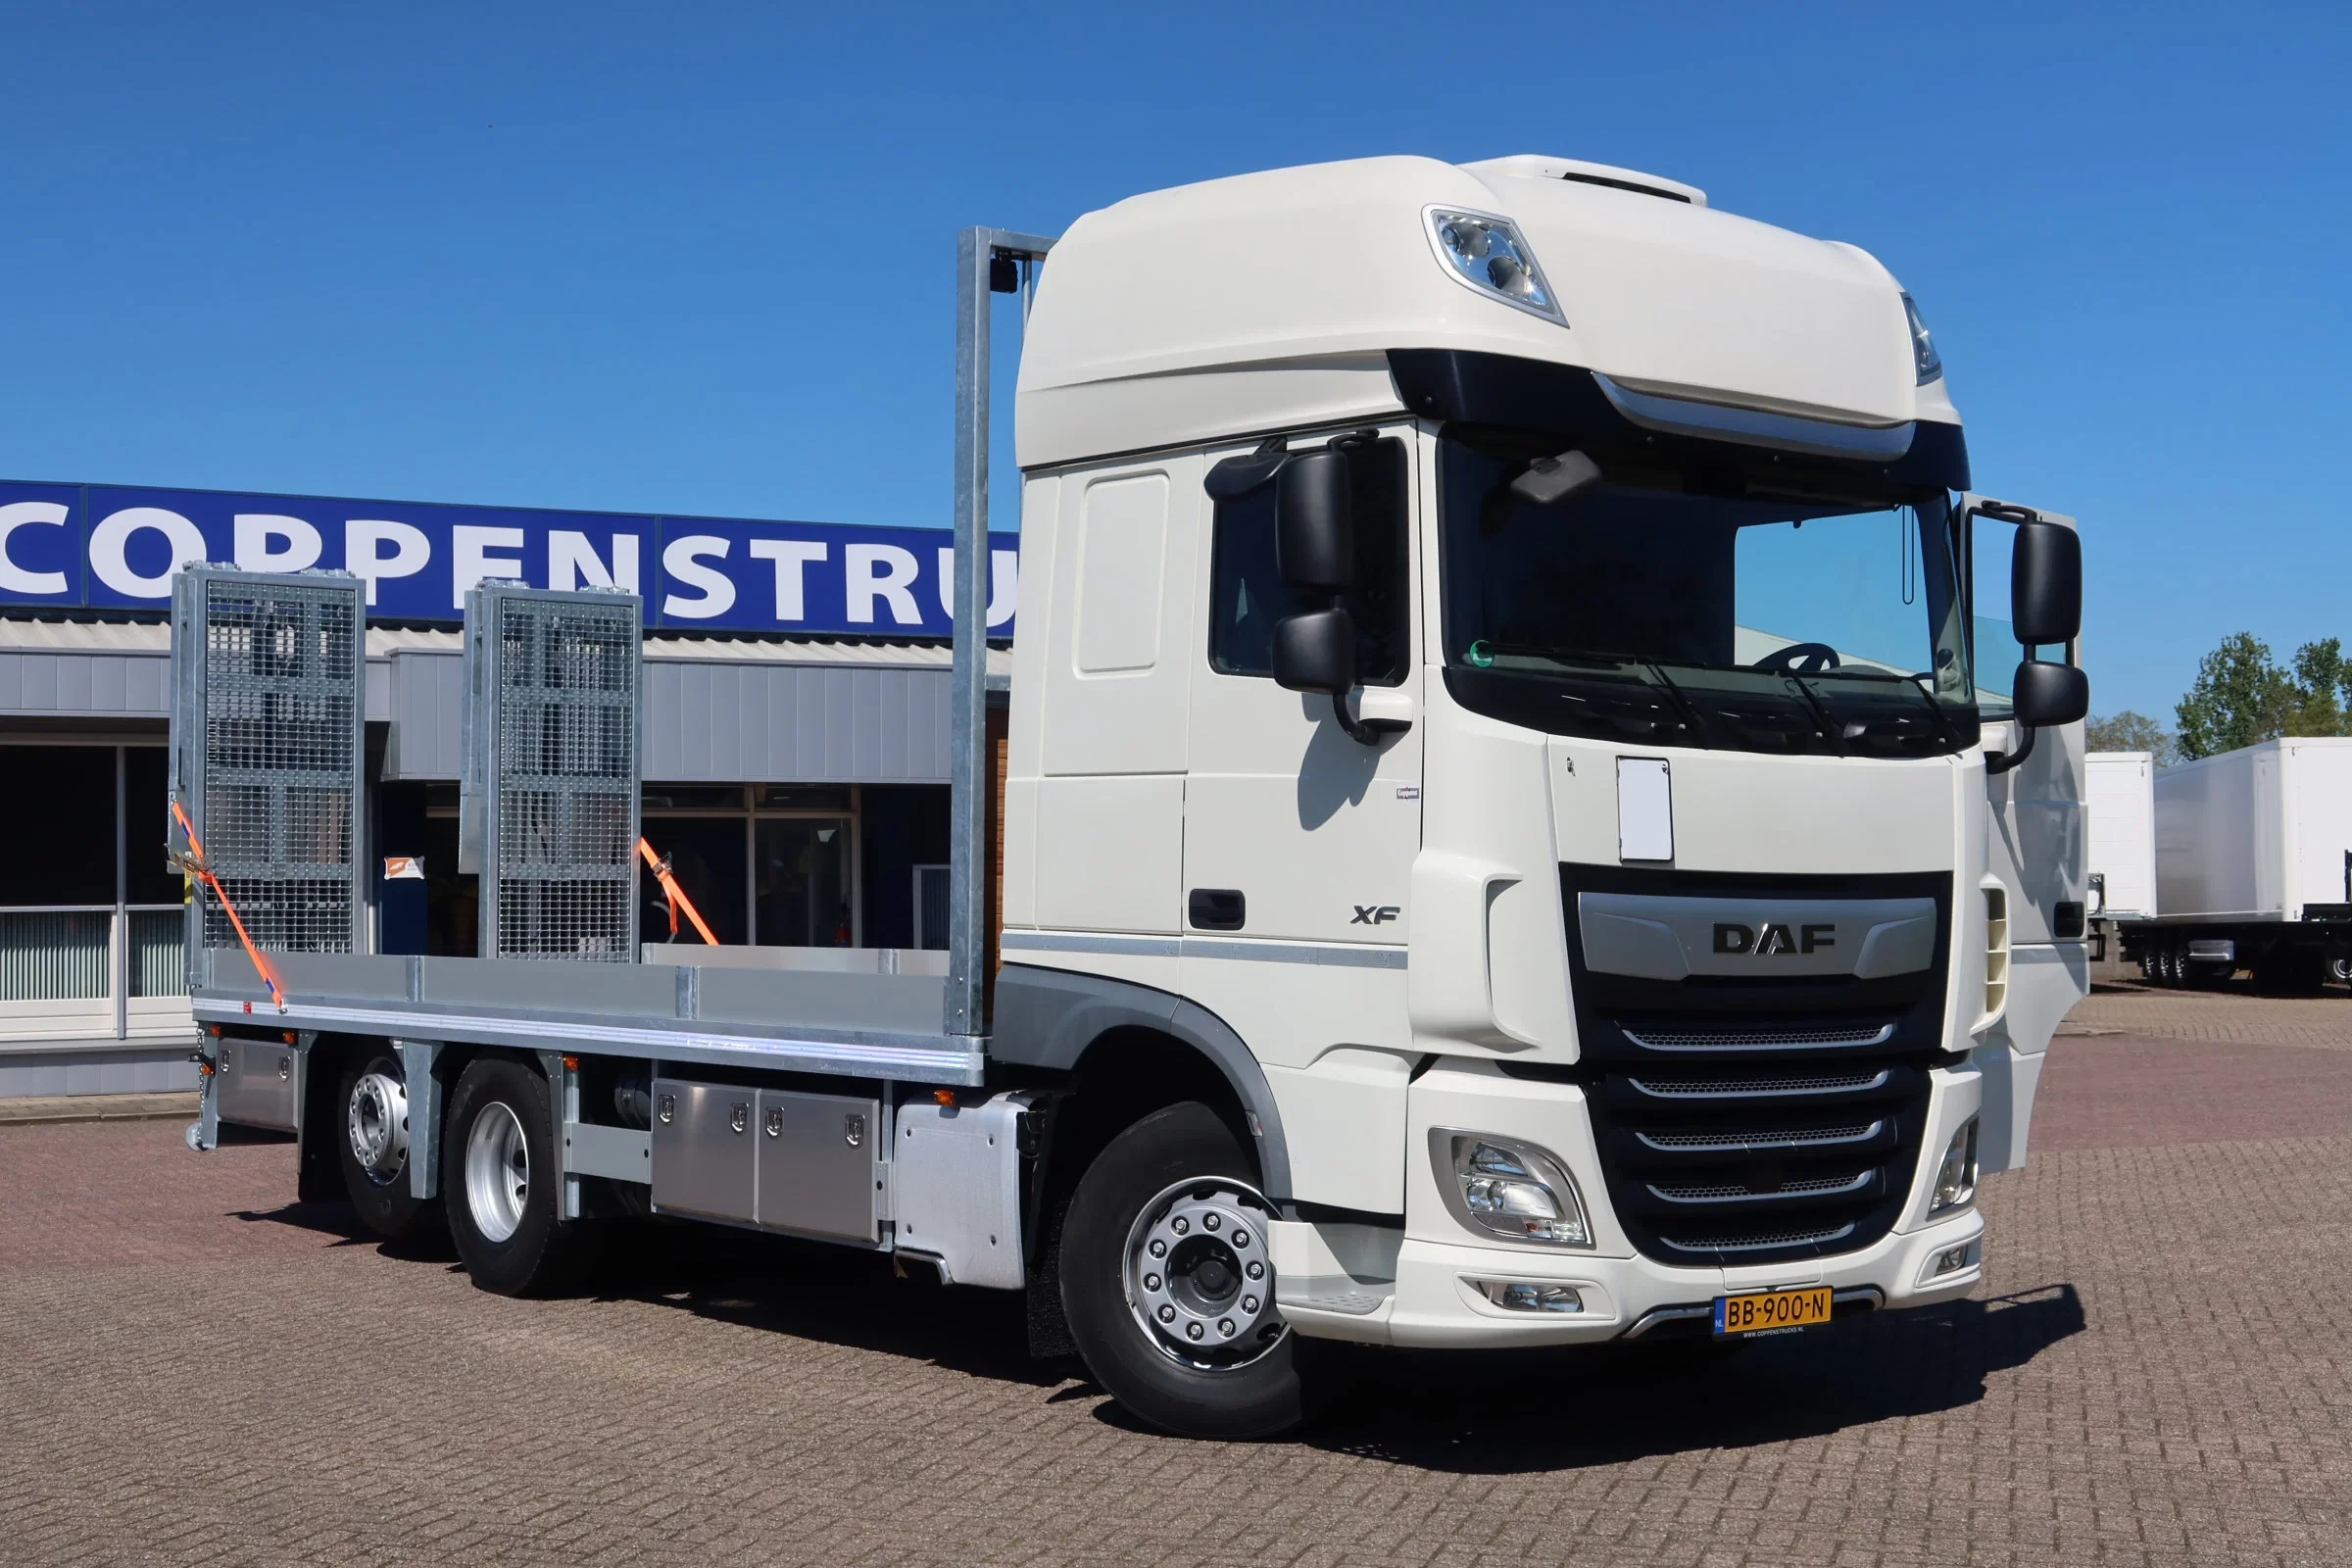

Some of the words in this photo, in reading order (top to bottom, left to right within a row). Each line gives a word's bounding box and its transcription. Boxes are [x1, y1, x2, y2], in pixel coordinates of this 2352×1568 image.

[1349, 905, 1401, 926] XF
[1713, 923, 1836, 956] DAF
[1715, 1319, 1724, 1329] NL
[1728, 1293, 1826, 1328] BB-900-N
